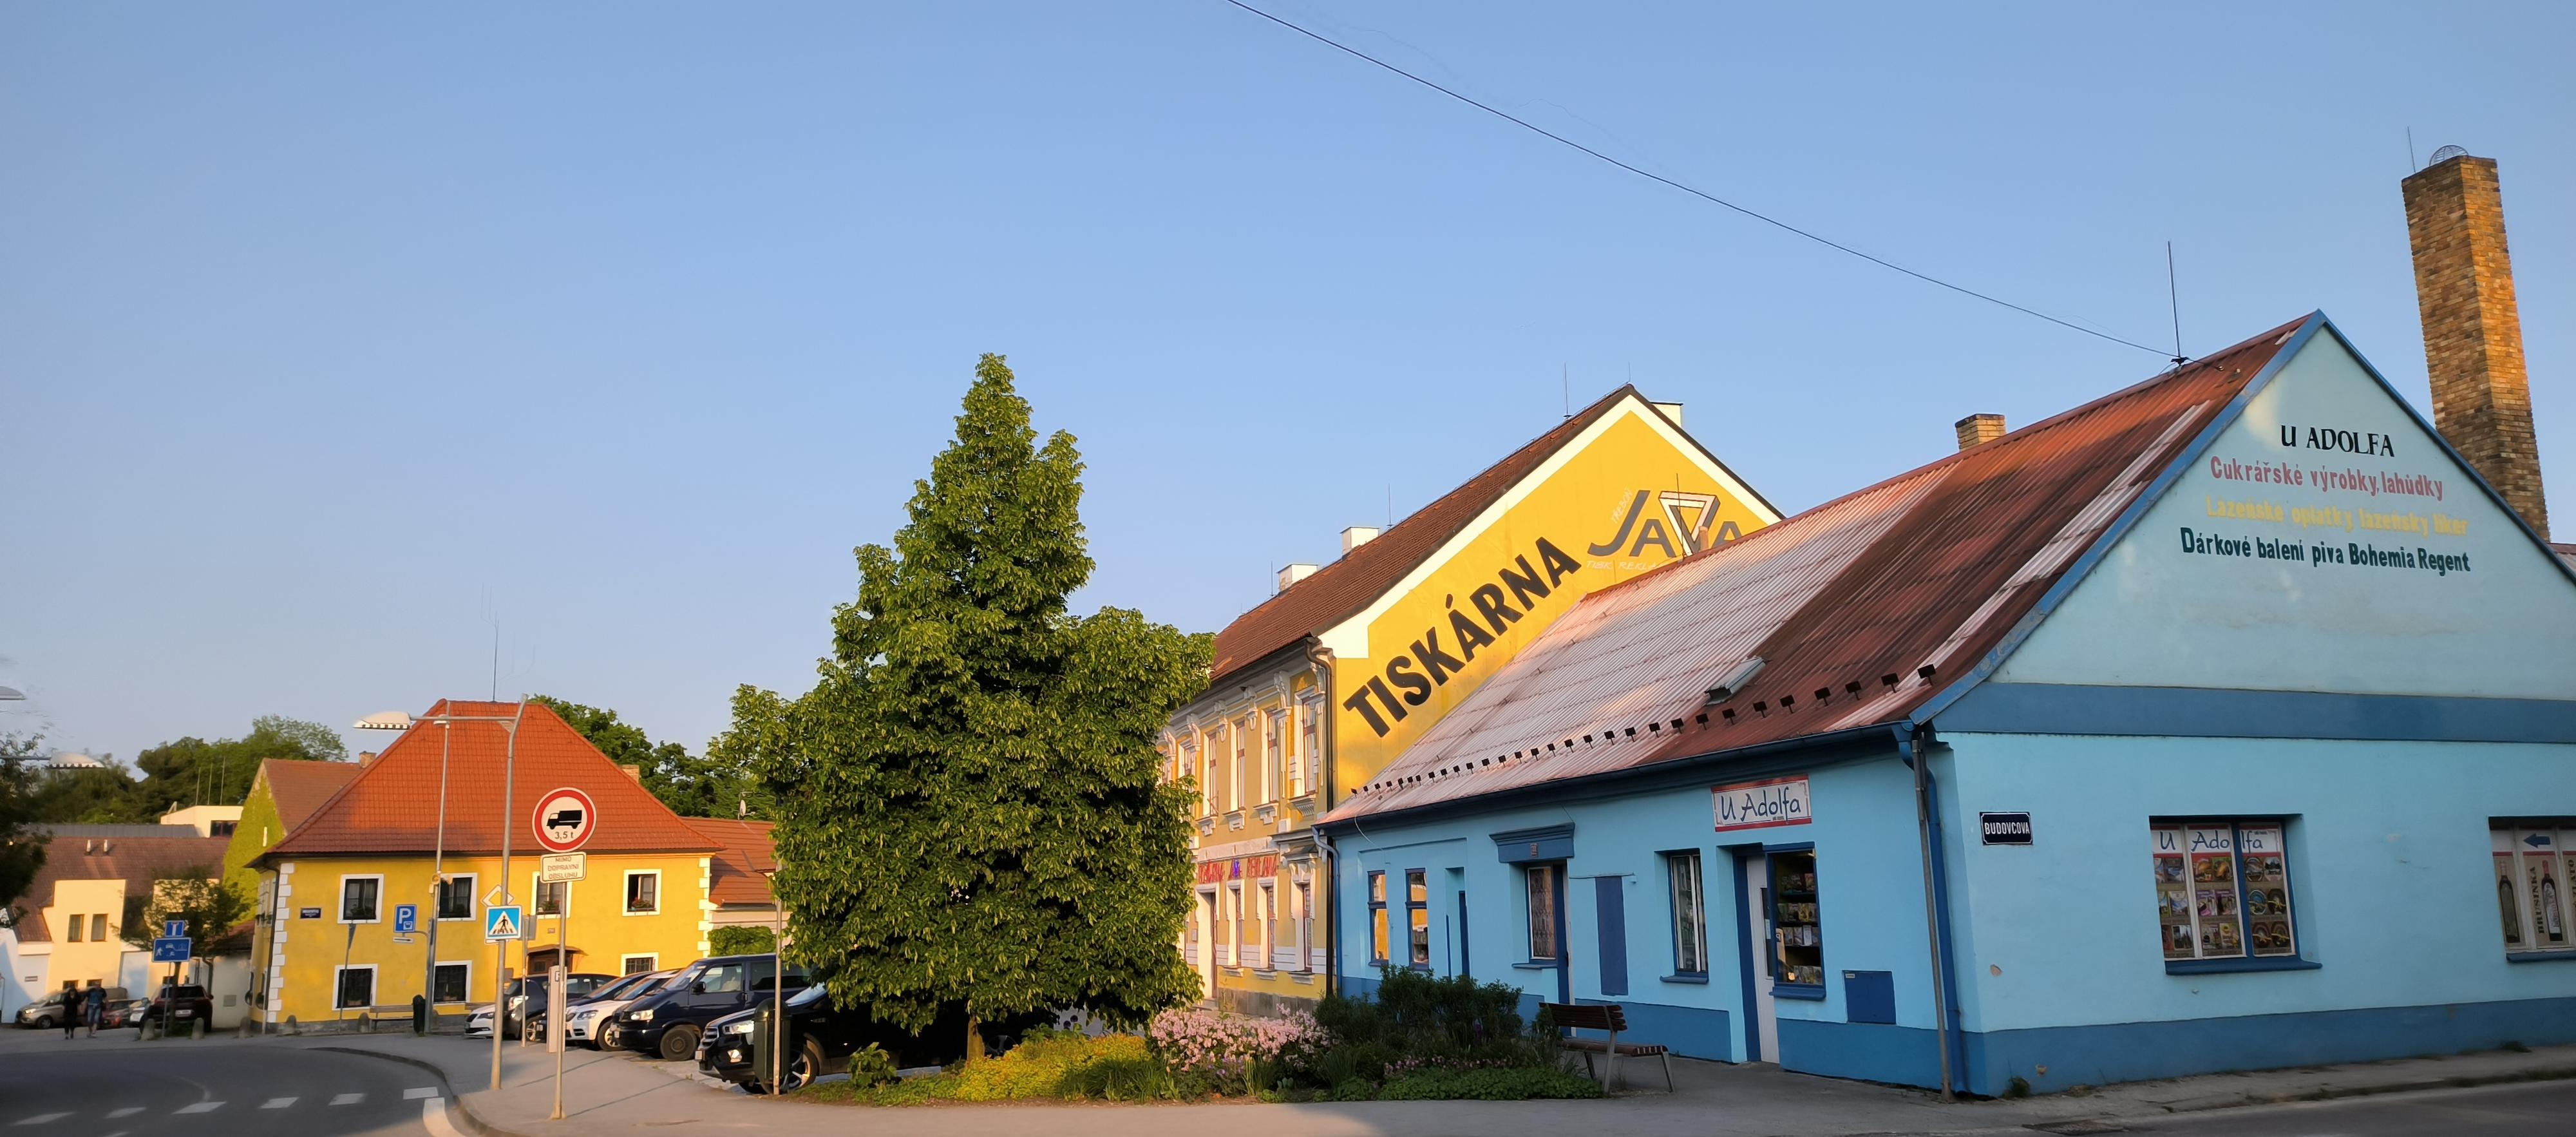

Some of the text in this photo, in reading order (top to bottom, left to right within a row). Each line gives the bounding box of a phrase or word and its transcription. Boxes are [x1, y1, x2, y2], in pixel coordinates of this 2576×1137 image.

[2281, 425, 2394, 457] U ADOLFA
[2210, 455, 2303, 486] Cukrářské
[2180, 527, 2470, 577] Dárkové balení piva Bohemia Regent
[1343, 537, 1582, 738] TISKÁRNA
[1721, 786, 1801, 825] U Adolfa
[554, 831, 568, 840] 3,5
[1984, 822, 2030, 835] BUDOVCOVA
[2159, 831, 2176, 850] U
[2530, 866, 2545, 934] BRUSINKA
[399, 908, 412, 924] P
